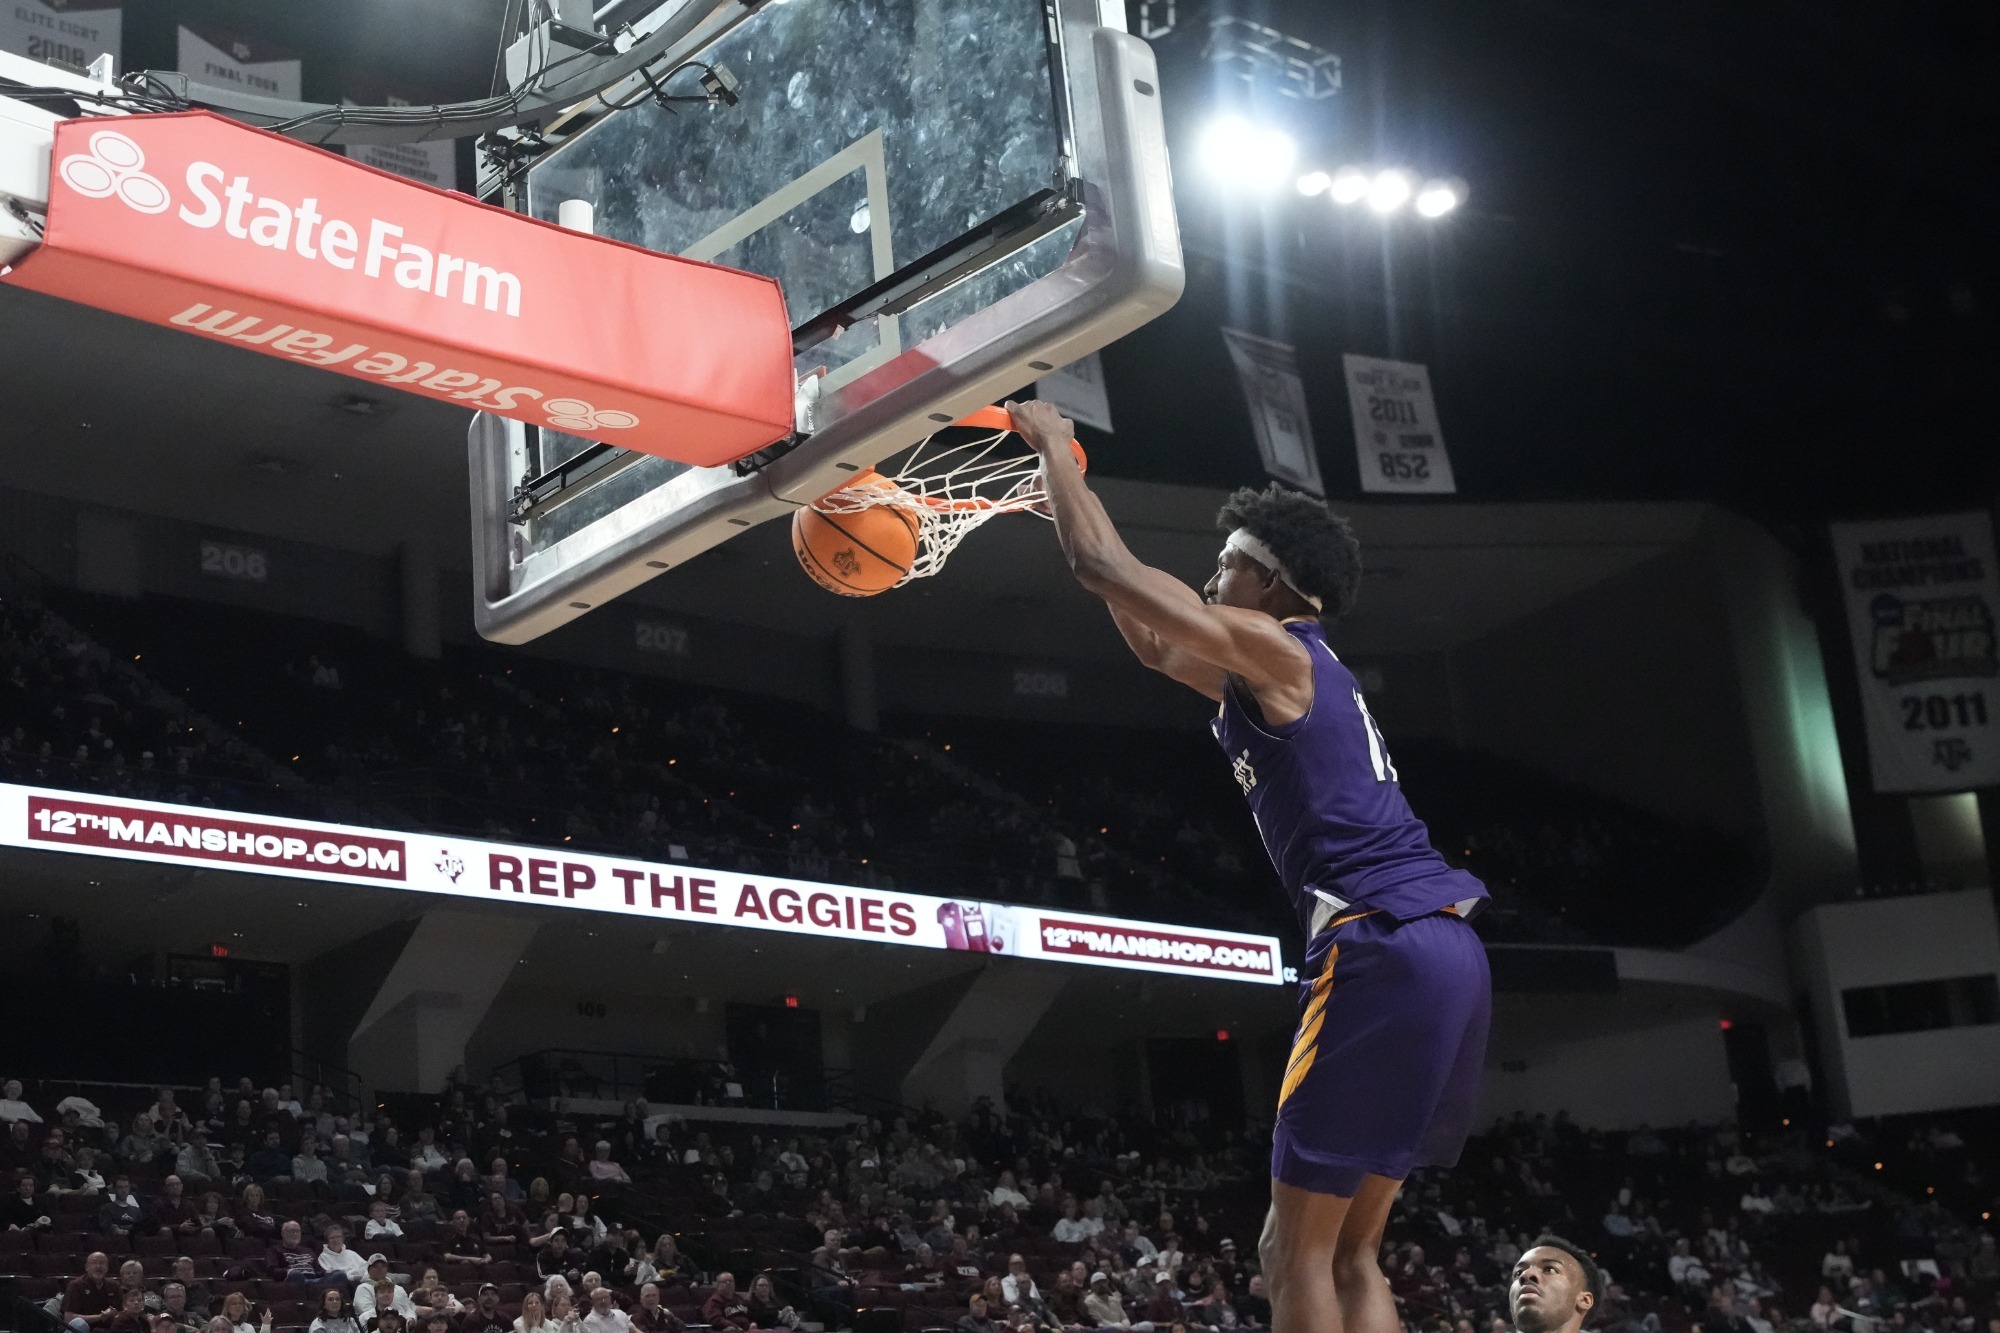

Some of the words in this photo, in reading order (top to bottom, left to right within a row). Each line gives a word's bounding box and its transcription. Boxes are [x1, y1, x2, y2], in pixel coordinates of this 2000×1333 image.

[15, 7, 53, 30] ELITE
[205, 62, 242, 83] FINAL
[247, 75, 279, 93] FOUR
[1367, 396, 1418, 424] 2011
[1379, 452, 1430, 479] 852
[201, 546, 267, 578] 206
[1861, 534, 1967, 563] NATIONAL
[1852, 558, 1985, 589] CHAMPIONS
[636, 624, 688, 656] 207
[1901, 692, 1988, 732] 2011
[488, 853, 597, 898] REP
[612, 868, 718, 915] THE
[734, 884, 917, 937] AGGIES
